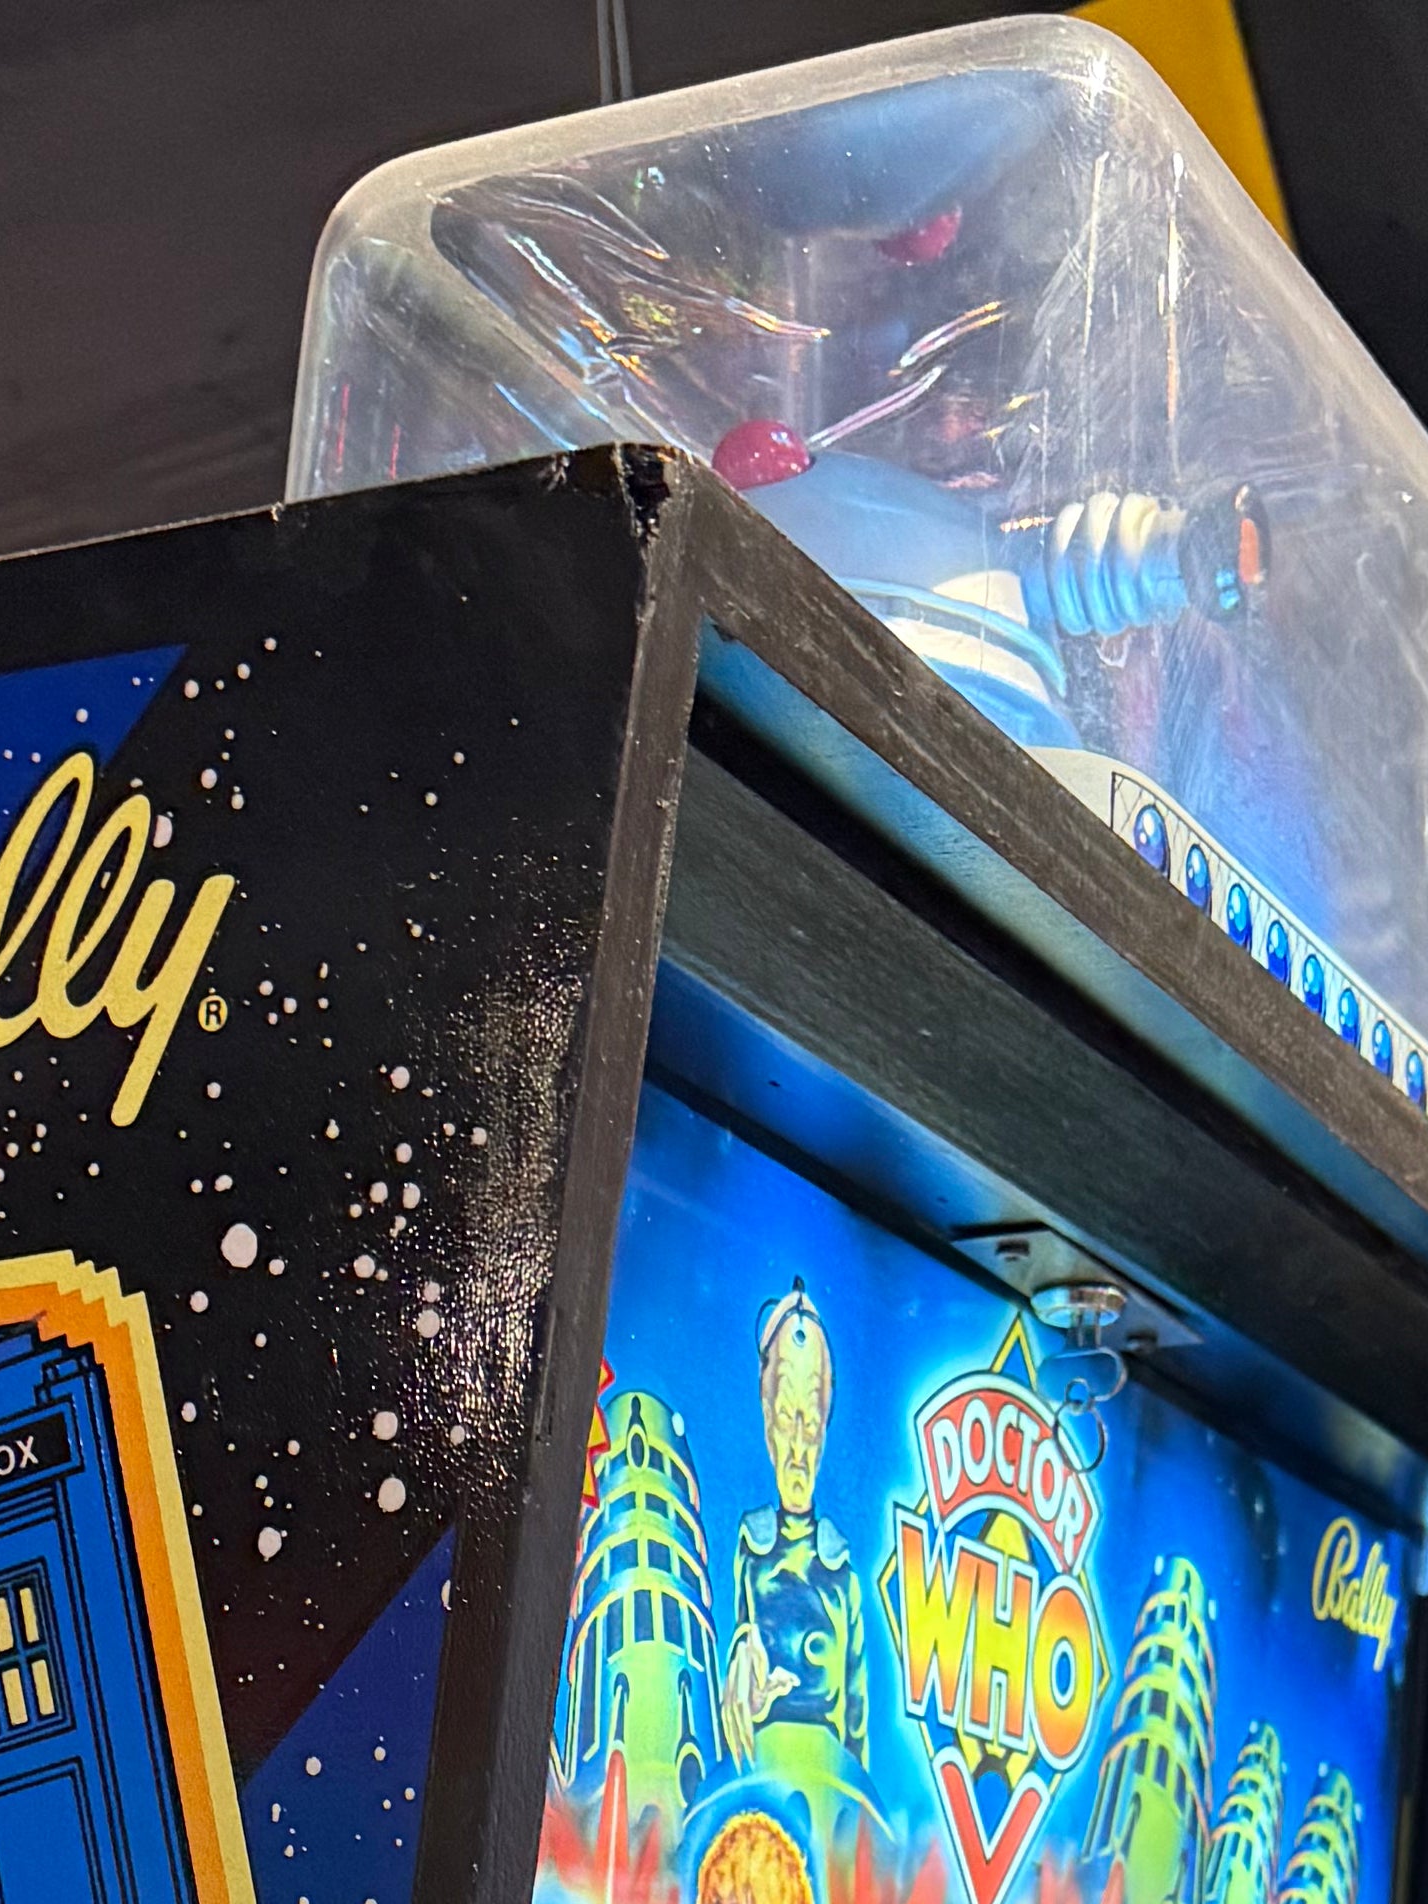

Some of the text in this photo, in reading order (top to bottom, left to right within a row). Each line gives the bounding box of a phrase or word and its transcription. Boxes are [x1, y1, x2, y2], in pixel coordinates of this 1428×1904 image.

[933, 1398, 1084, 1557] DOCTOR
[893, 1500, 1101, 1772] WHO
[1312, 1515, 1399, 1672] Bally
